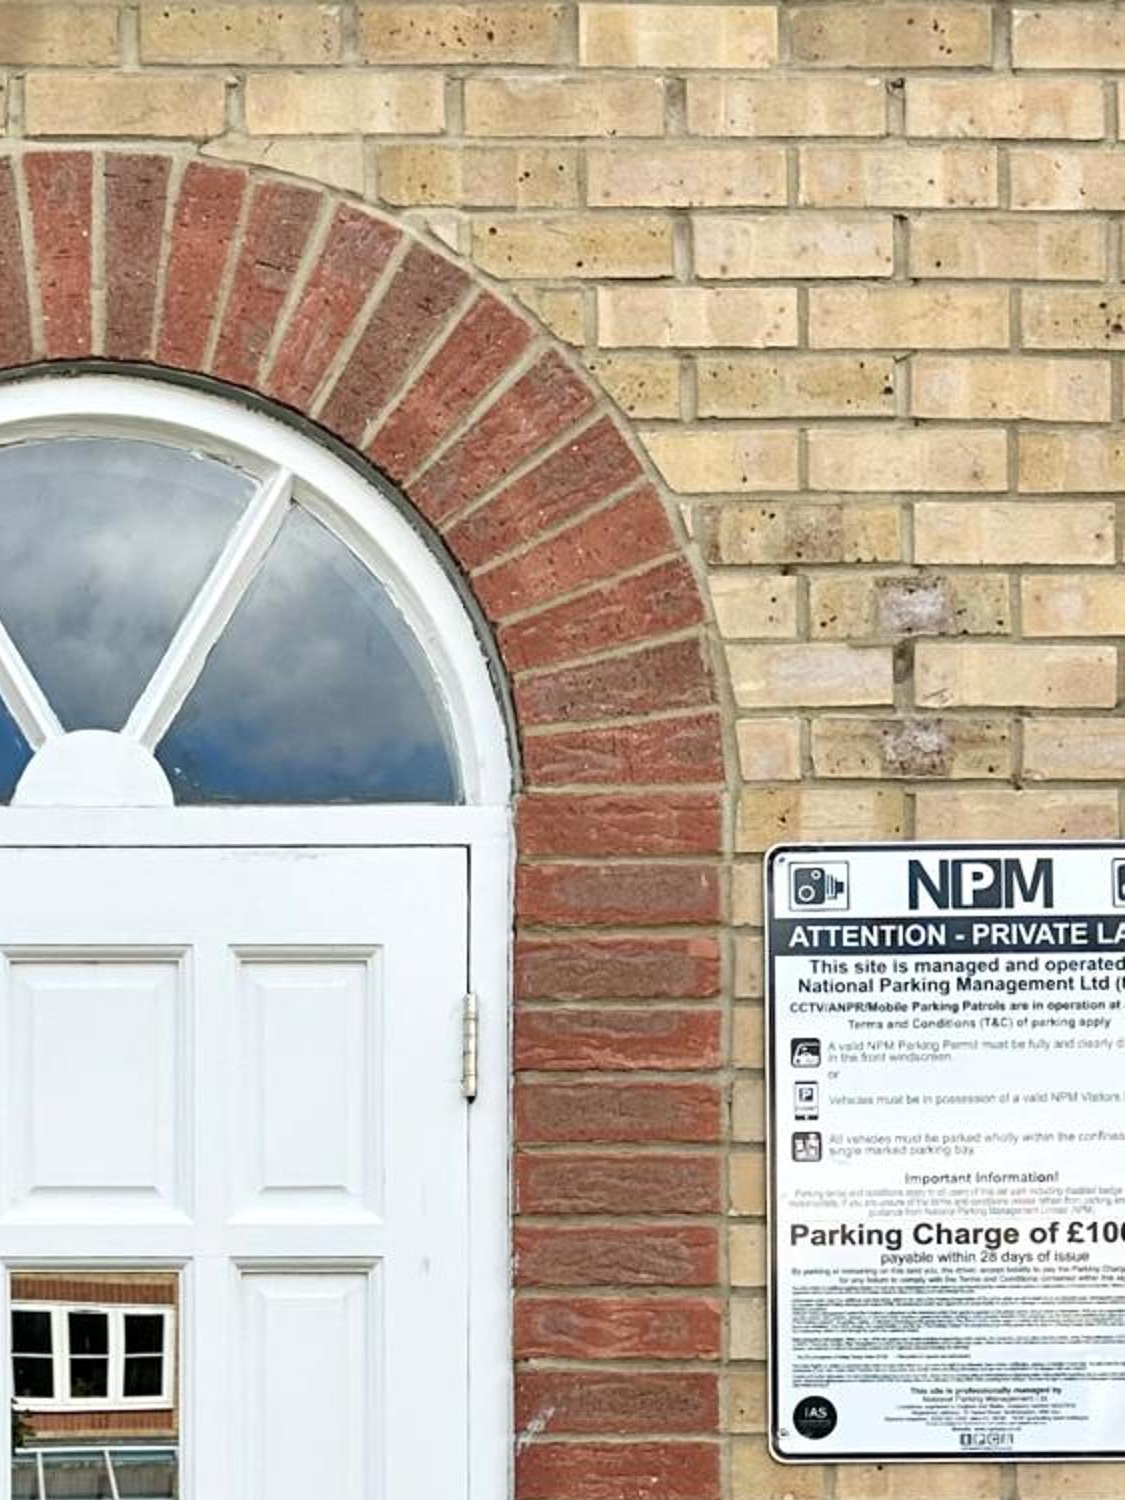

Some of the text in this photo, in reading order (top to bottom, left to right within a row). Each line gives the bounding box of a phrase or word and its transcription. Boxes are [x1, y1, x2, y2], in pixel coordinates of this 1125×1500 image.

[908, 858, 1053, 910] NPM
[789, 924, 946, 947] ATTENTION
[972, 923, 1088, 946] PRIVATE
[810, 957, 1125, 976] This site is managed and operated
[798, 978, 874, 993] National
[880, 977, 950, 995] Parking
[956, 976, 1075, 995] Management
[1081, 975, 1110, 991] Ltd
[911, 1001, 959, 1014] Parking
[962, 1000, 1006, 1011] Patrols
[1009, 1002, 1029, 1011] are
[1032, 1000, 1044, 1011] in
[1047, 1000, 1106, 1013] operation
[848, 1019, 883, 1029] Terms
[886, 1019, 909, 1029] and
[912, 1018, 976, 1029] Conditions
[1017, 1018, 1029, 1027] of
[1031, 1018, 1076, 1029] parking
[1079, 1017, 1112, 1029] apply
[905, 1171, 1059, 1185] Important Information!
[790, 1223, 902, 1251] Parking
[913, 1221, 1019, 1250] Charge
[1029, 1221, 1060, 1244] of
[880, 1250, 1090, 1266] payable within 28 days of issue
